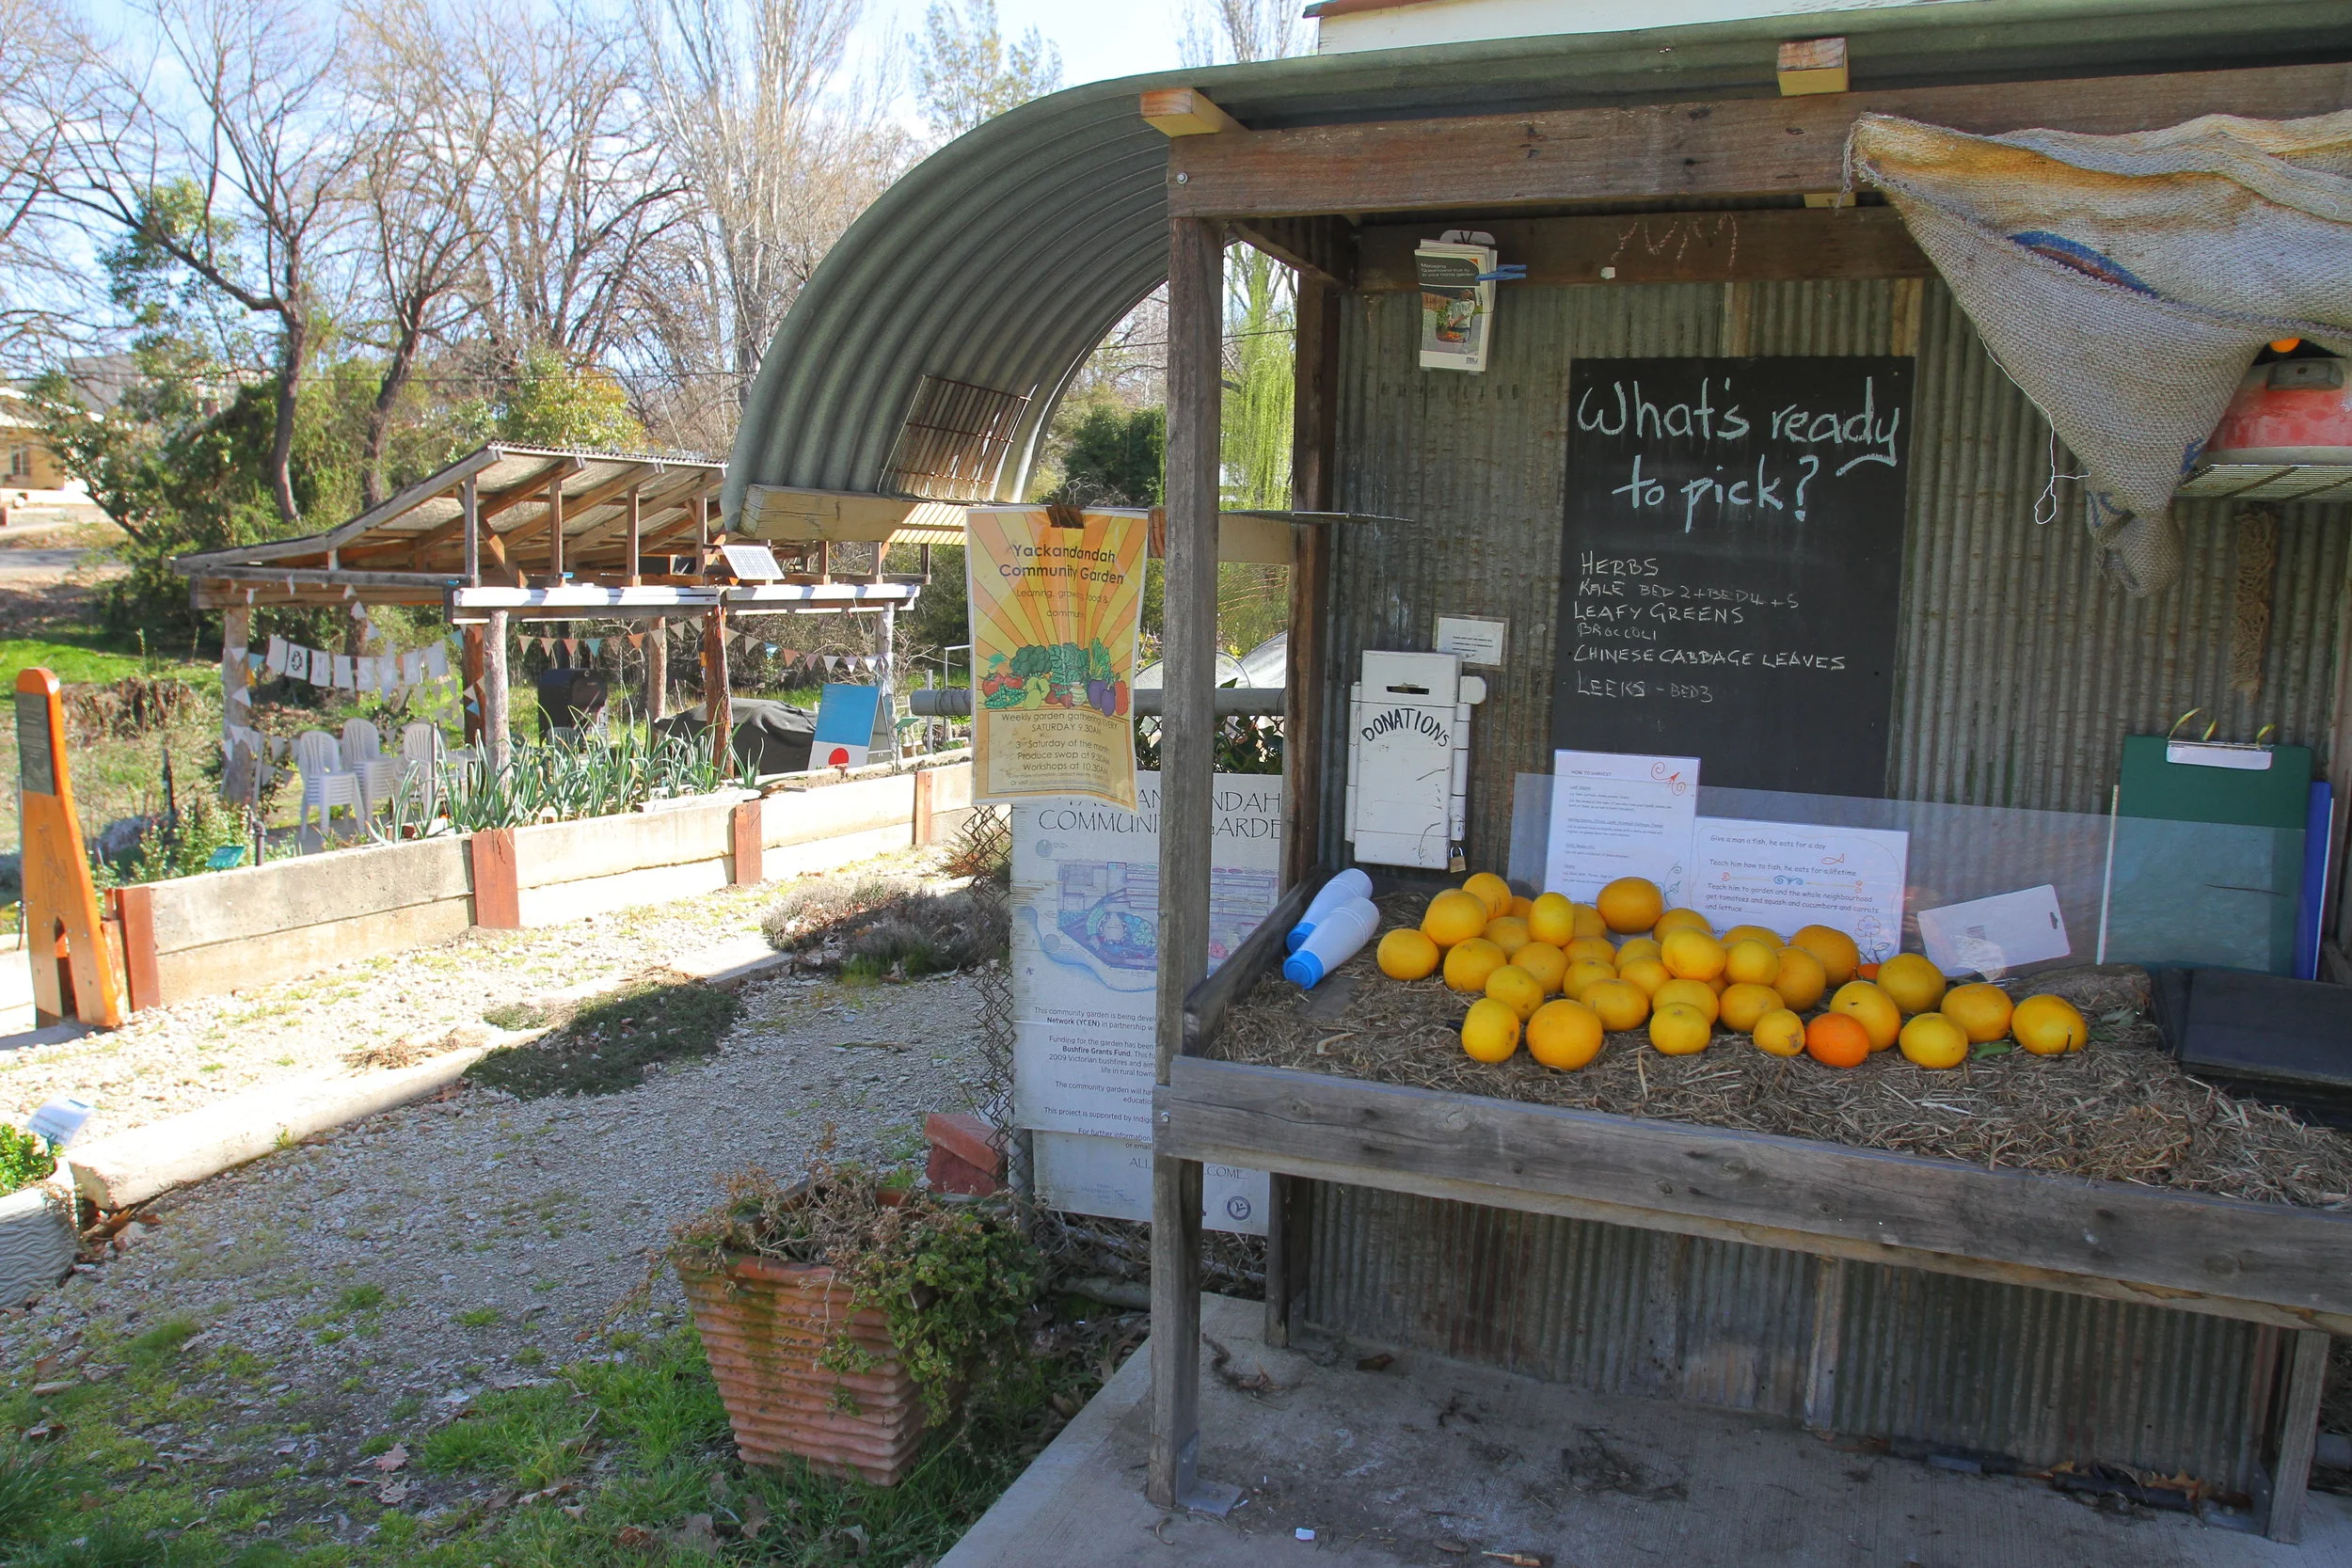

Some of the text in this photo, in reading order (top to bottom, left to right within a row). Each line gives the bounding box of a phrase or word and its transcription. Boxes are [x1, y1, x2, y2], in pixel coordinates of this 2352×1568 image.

[1578, 376, 1900, 477] What's ready
[1611, 452, 1820, 534] to pick?
[1013, 544, 1116, 563] Yackandandah
[1581, 550, 1659, 576] HERBS
[999, 563, 1124, 585] Community Garden
[1579, 578, 1626, 597] KALE
[1573, 601, 1744, 624] LEAFY GREENS
[1577, 622, 1657, 641] BROCCOLI
[1573, 644, 1846, 672] CHINESE CABBAGE LEAVES
[1577, 671, 1646, 698] LEEKS
[1001, 714, 1030, 722] Weekly
[1033, 712, 1065, 722] garden
[1031, 722, 1075, 732] SATURDAY
[1361, 707, 1450, 748] DONATIONS
[1028, 739, 1065, 749] Saturday
[1079, 739, 1092, 749] the
[1018, 752, 1052, 760] Produce
[1055, 752, 1078, 760] swap
[1081, 751, 1089, 759] at
[1024, 763, 1067, 771] Workshops
[1212, 816, 1281, 840] ARDE
[1752, 838, 1768, 847] fish,
[1814, 842, 1827, 851] day
[1708, 858, 1729, 866] Teach
[1730, 860, 1742, 868] him
[1829, 867, 1857, 877] lifetime
[1708, 882, 1729, 892] Teach
[1751, 886, 1773, 895] garden
[1789, 888, 1801, 896] the
[1802, 890, 1821, 899] whole
[1822, 892, 1873, 903] neighbourhood
[1706, 894, 1879, 913] get tomatoes and squash and cucumbers and carrots
[1718, 903, 1742, 912] lettuce
[1046, 1016, 1074, 1025] Network
[1076, 1019, 1101, 1027] (YCEN)
[1110, 1022, 1146, 1031] partnership
[1048, 1008, 1084, 1018] community
[1086, 1010, 1108, 1020] garden
[1118, 1012, 1136, 1022] being
[1050, 1036, 1074, 1044] Funding
[1069, 1055, 1097, 1064] Victorian
[1099, 1058, 1127, 1067] bushfires
[1069, 1083, 1104, 1092] community
[1106, 1085, 1129, 1094] garden
[1044, 1106, 1057, 1115] This
[1058, 1108, 1081, 1117] project
[1089, 1111, 1122, 1121] supported
[1123, 1114, 1132, 1122] by
[1091, 1129, 1112, 1137] further
[1114, 1131, 1152, 1142] information
[1129, 1158, 1152, 1169] ALL
